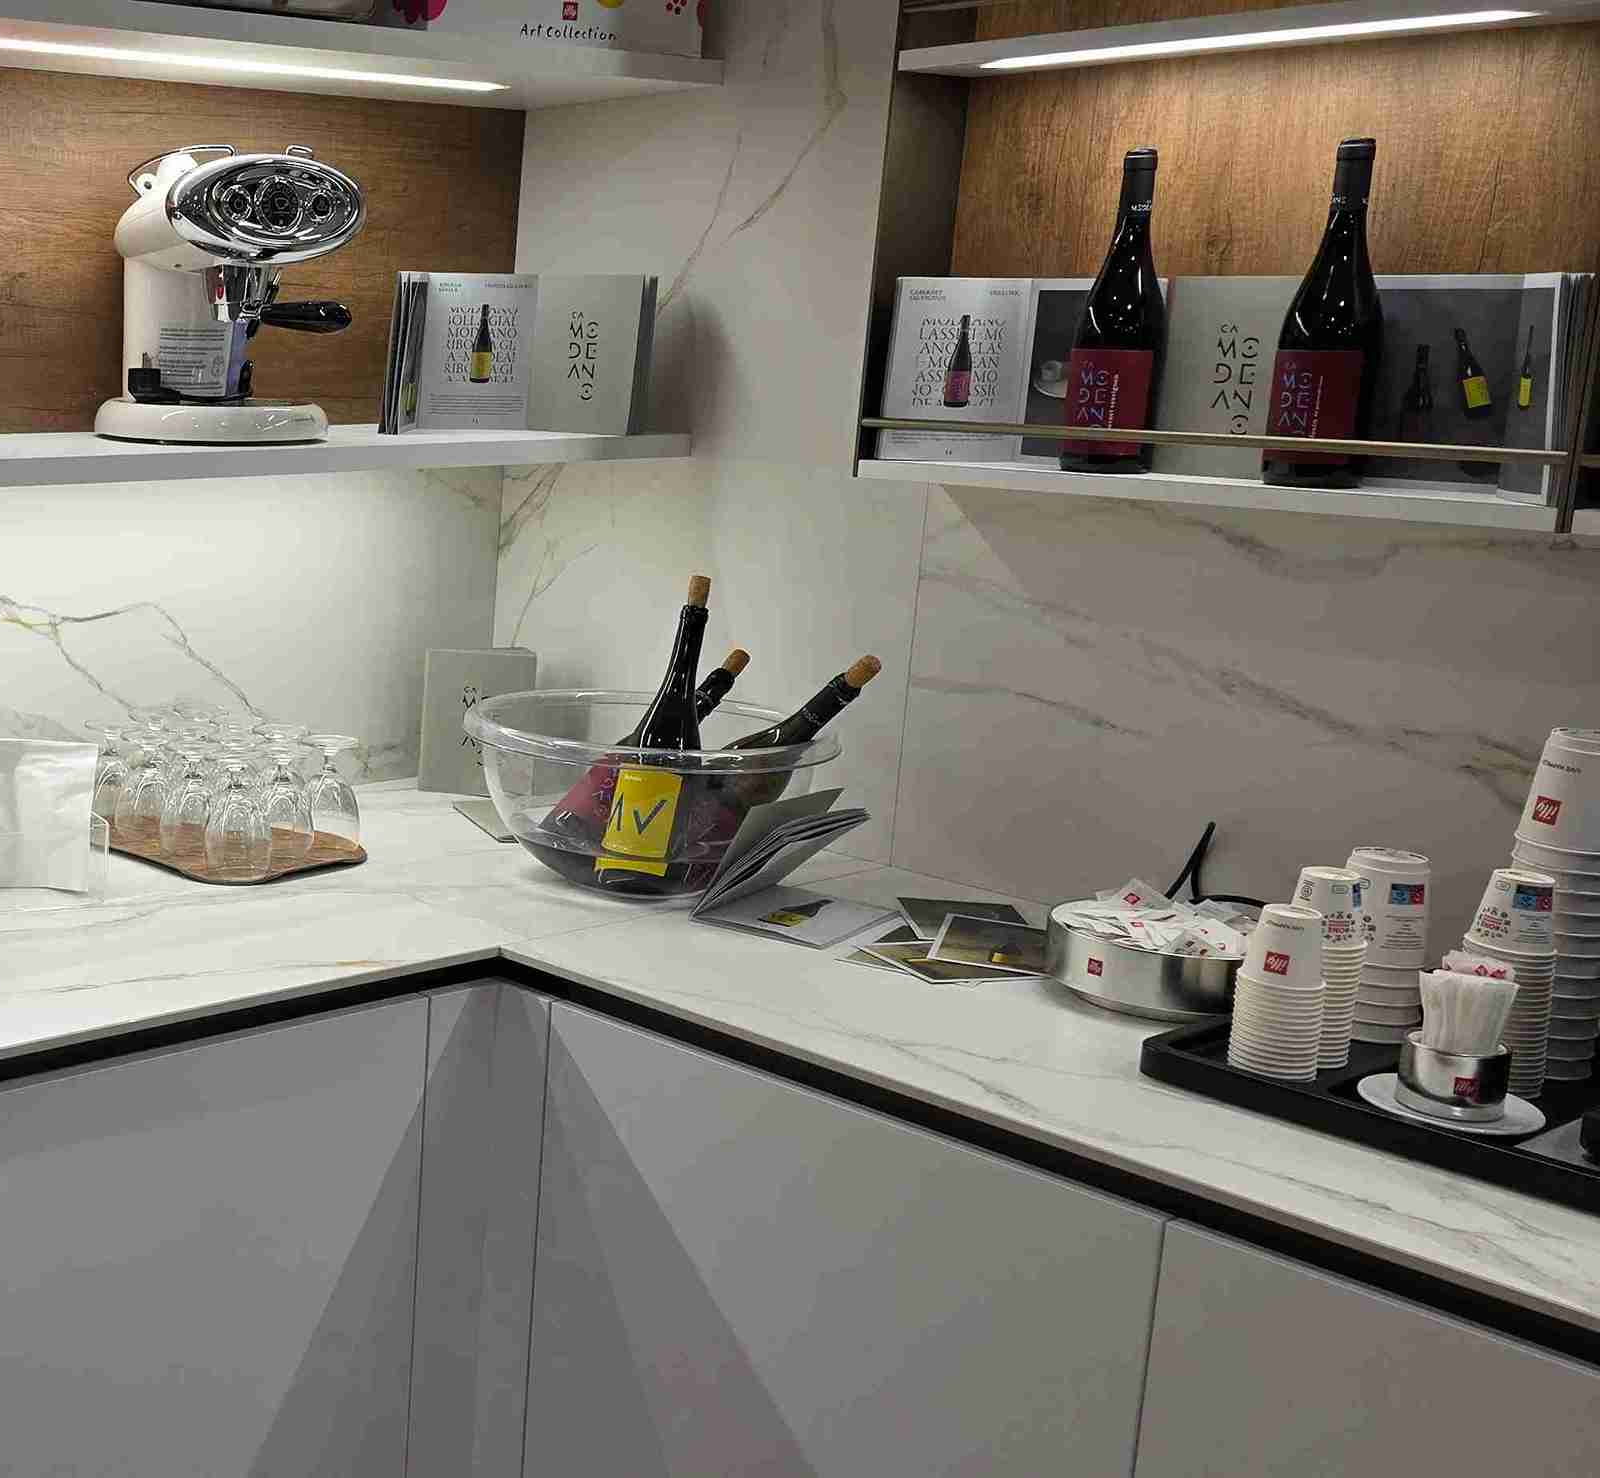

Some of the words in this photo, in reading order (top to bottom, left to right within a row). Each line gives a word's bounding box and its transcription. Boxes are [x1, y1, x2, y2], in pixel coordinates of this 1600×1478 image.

[521, 23, 543, 37] Art
[546, 25, 617, 40] Collection
[1213, 362, 1257, 385] DE
